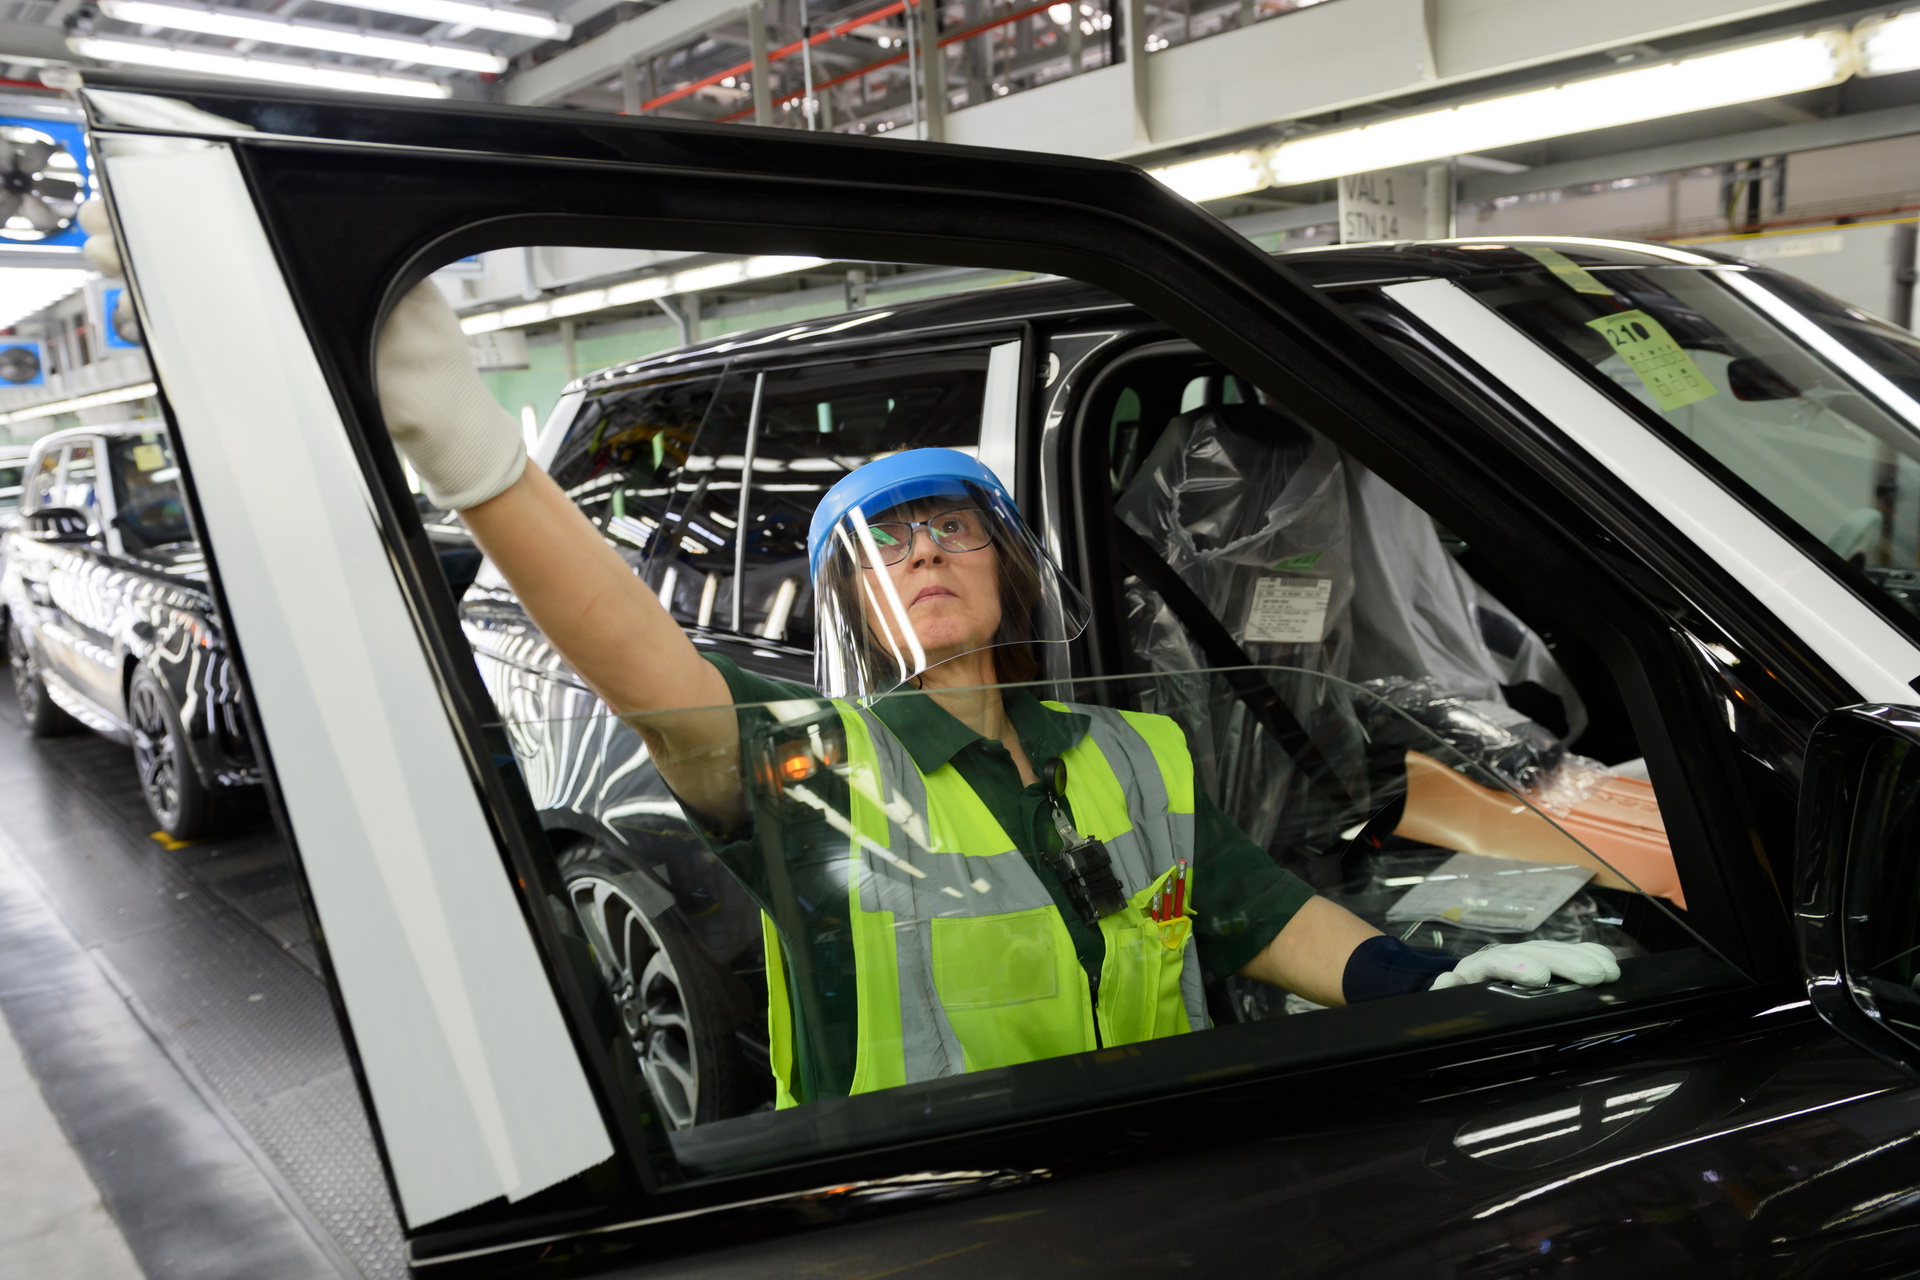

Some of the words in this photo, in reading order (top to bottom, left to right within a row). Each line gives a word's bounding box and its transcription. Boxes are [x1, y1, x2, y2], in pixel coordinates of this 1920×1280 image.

[1343, 175, 1380, 205] VAL
[1385, 177, 1395, 206] 1
[1346, 211, 1377, 238] STN
[1380, 214, 1399, 239] 14
[1607, 322, 1651, 346] 210
